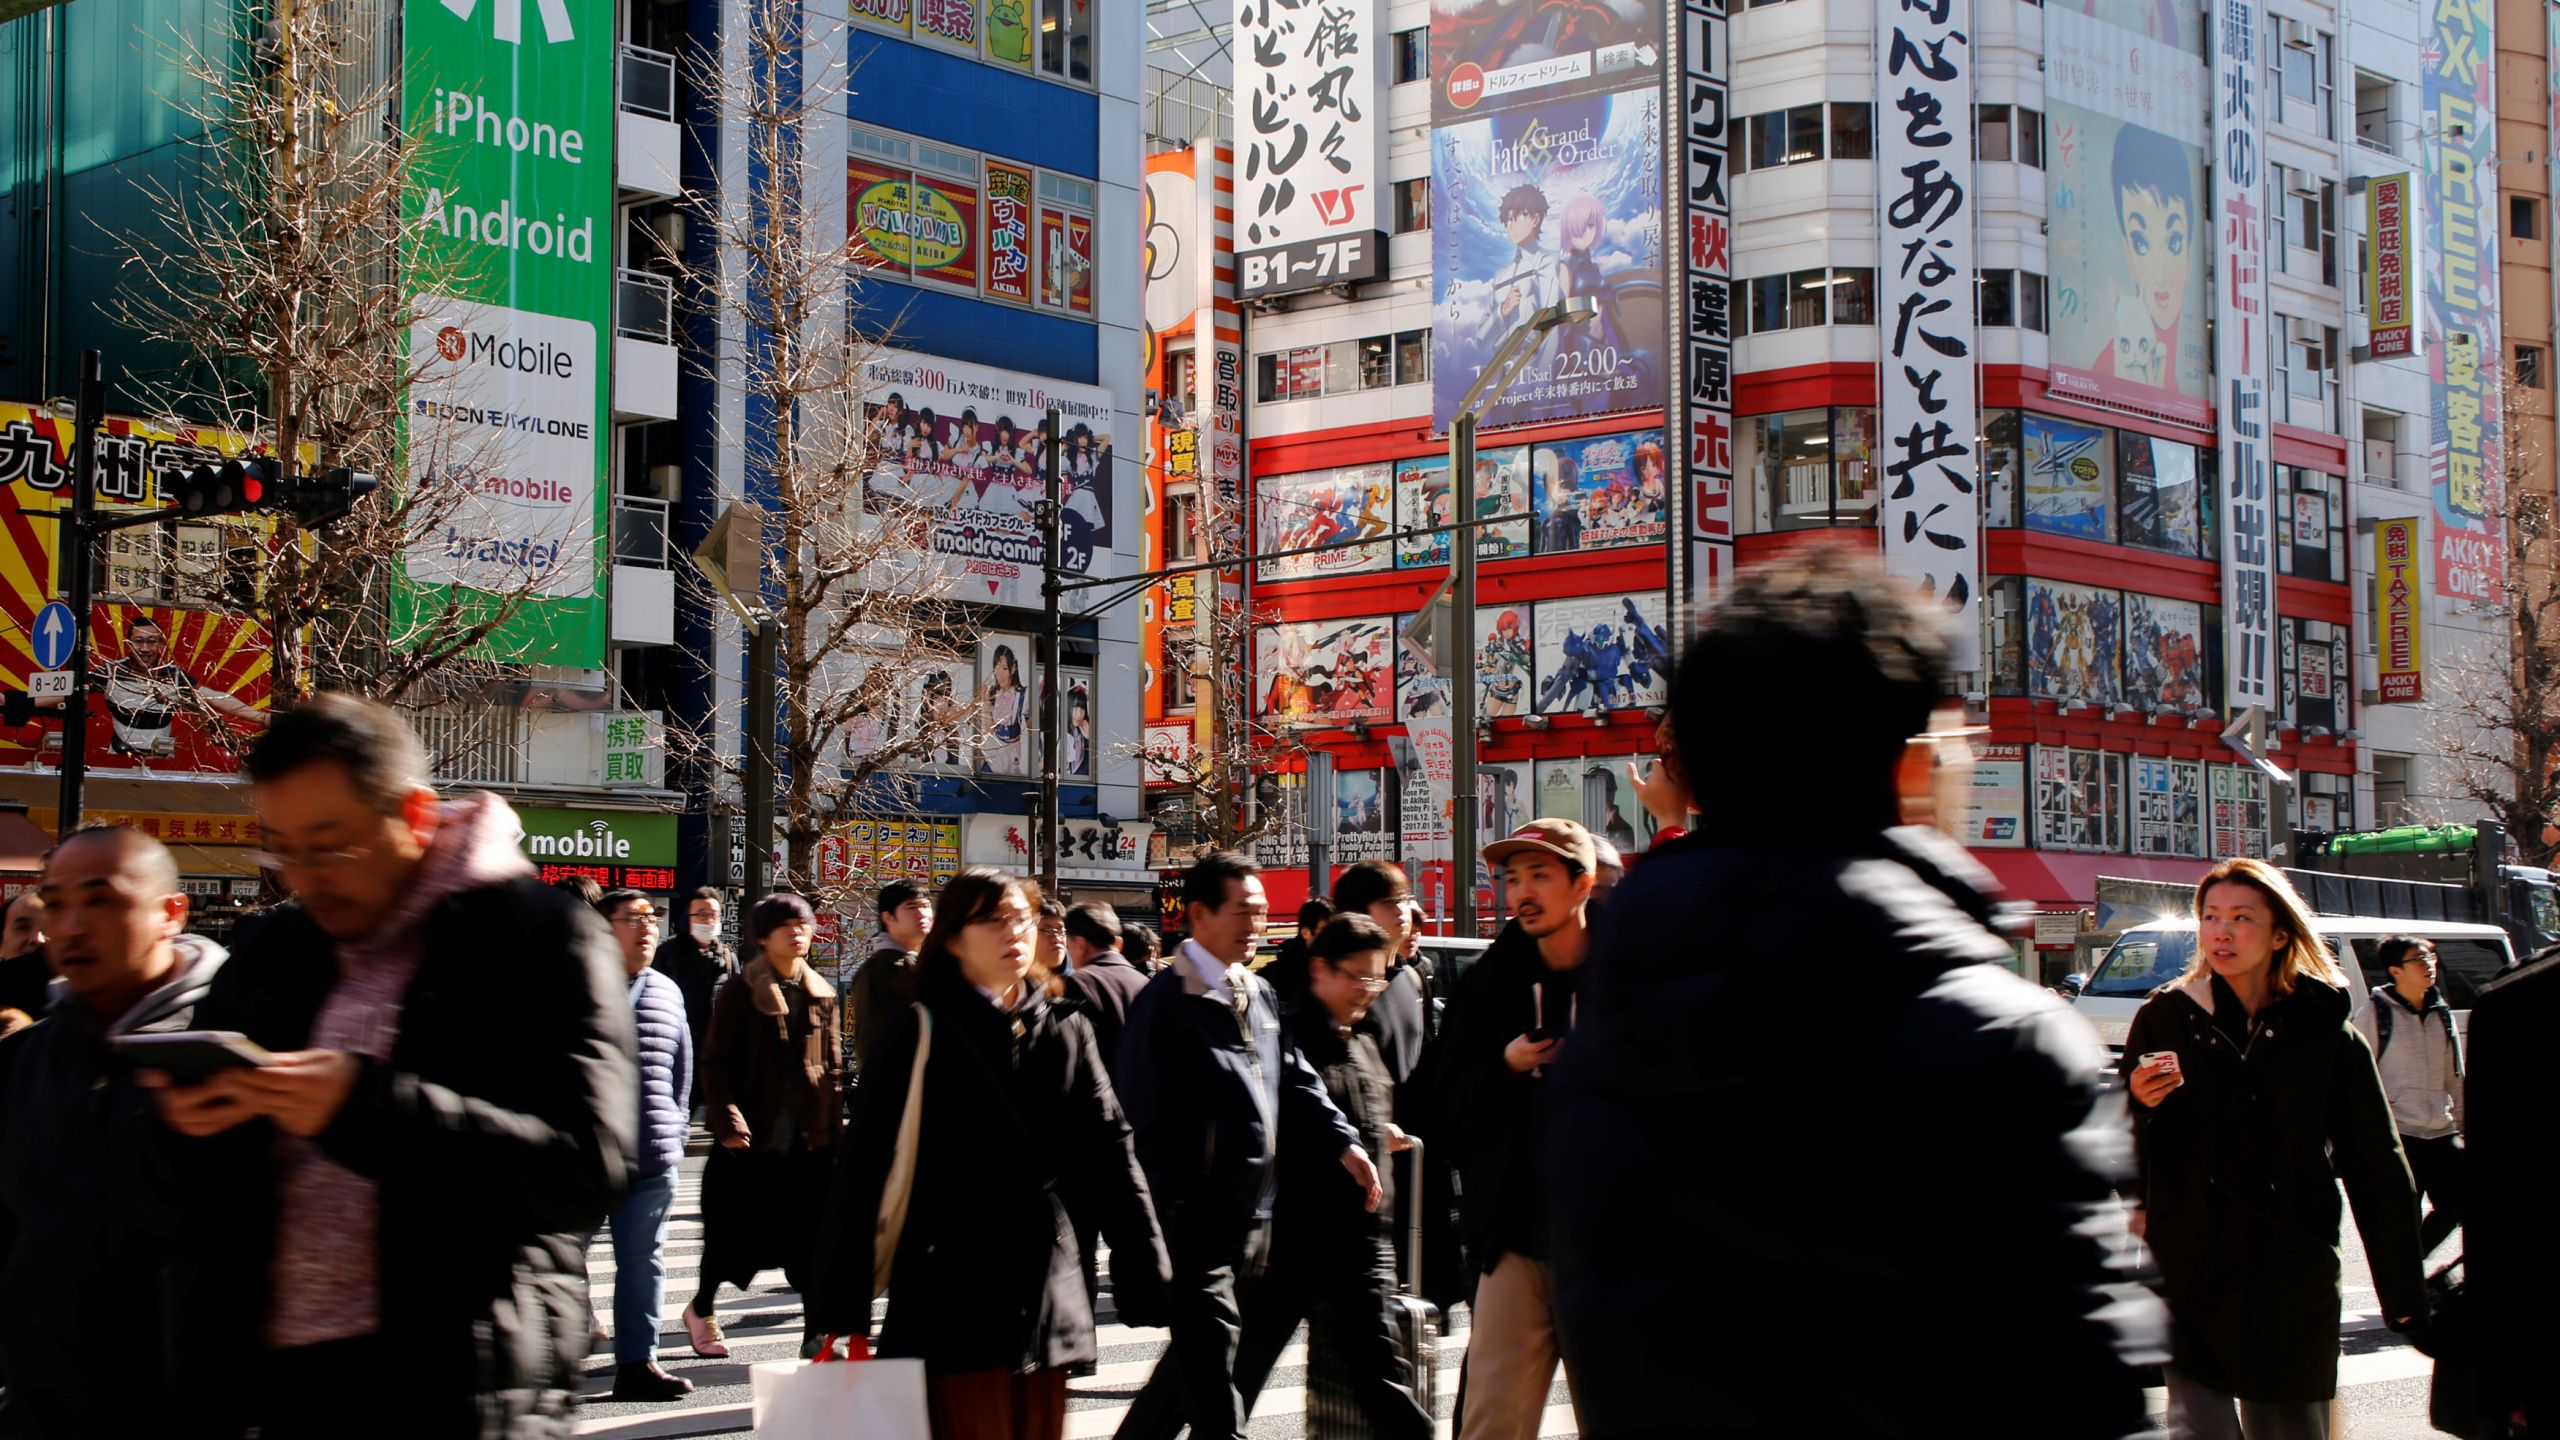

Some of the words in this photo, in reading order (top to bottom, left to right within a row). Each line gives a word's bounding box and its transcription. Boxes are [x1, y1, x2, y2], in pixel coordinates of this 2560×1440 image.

[918, 0, 974, 41] 喫茶
[1602, 50, 1629, 67] 検索
[1451, 79, 1480, 94] 詳細は
[1488, 61, 1580, 91] ドルフィードリーム
[434, 89, 583, 163] iPhone
[1490, 138, 1530, 176] Fate
[1530, 118, 1590, 149] Grand
[1557, 138, 1617, 166] Order
[988, 170, 1030, 203] 麻雀
[1641, 100, 1660, 271] 未来を取り戻す
[424, 187, 593, 264] Android
[863, 203, 961, 245] WELCOME
[916, 206, 946, 217] PARADISE
[992, 201, 1028, 280] ウェルカム
[1445, 137, 1461, 321] すべてはここから
[916, 246, 945, 260] AKIBA
[2377, 180, 2402, 324] 愛客旺免税店
[992, 282, 1023, 296] AKIBA
[1686, 0, 1731, 600] ークス秋葉原ホビー
[2373, 328, 2408, 342] AKKY
[2377, 340, 2404, 353] ONE
[471, 331, 573, 379] Mobile
[1216, 350, 1238, 433] 買取り
[2068, 379, 2087, 389] VOLKS
[487, 410, 546, 434] モバイル
[547, 420, 589, 439] ONE
[484, 476, 573, 503] mobile
[445, 527, 559, 568] brastel
[936, 530, 1046, 564] maidreamin
[2385, 525, 2408, 559] 免税
[2441, 535, 2495, 567] AKKY
[1066, 547, 1086, 569] 2F
[1313, 551, 1347, 567] PRIME
[2387, 562, 2410, 608] TAX
[2448, 566, 2489, 598] ONE
[2389, 611, 2411, 671] FREE
[2301, 672, 2326, 695] 天国
[2383, 674, 2417, 687] AKKY
[2387, 686, 2414, 698] ONE
[1646, 690, 1667, 702] SAL
[607, 718, 645, 748] 携帯
[606, 752, 643, 781] 買取
[2138, 762, 2168, 791] 5F
[1403, 805, 1421, 813] Hobby
[529, 829, 630, 858] mobile
[850, 824, 946, 847] インターネット
[1037, 827, 1124, 861] 士そば
[1120, 836, 1136, 849] 24
[1341, 843, 1362, 852] Hobby
[1365, 841, 1395, 851] Paraise
[850, 852, 928, 873] まんが
[1119, 850, 1135, 861] 時間
